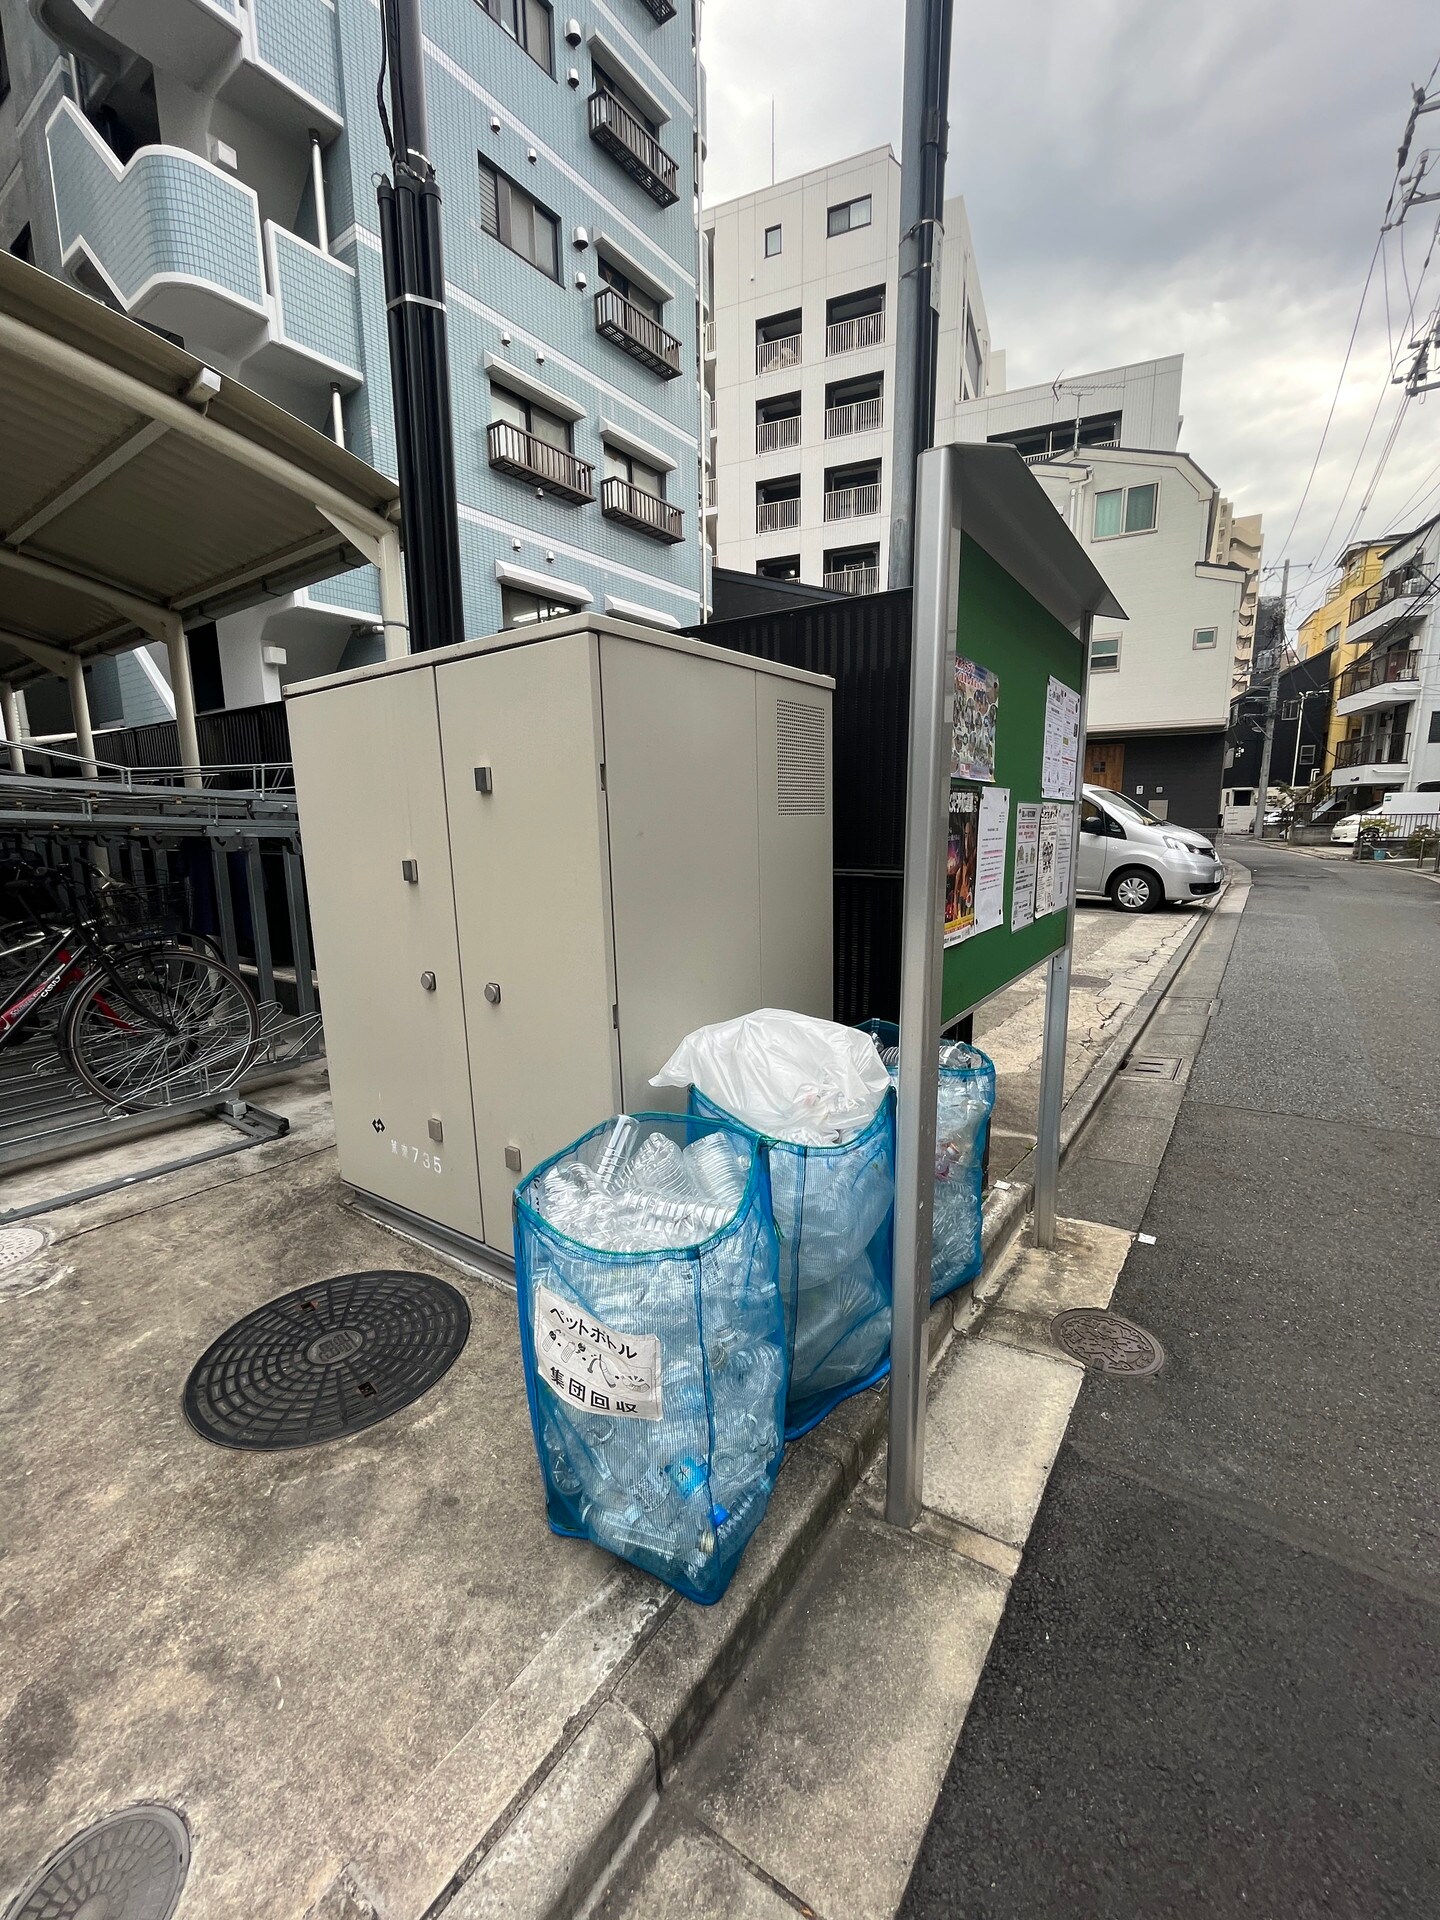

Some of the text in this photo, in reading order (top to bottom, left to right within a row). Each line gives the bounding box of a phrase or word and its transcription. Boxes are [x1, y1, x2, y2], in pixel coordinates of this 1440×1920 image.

[550, 1307, 638, 1360] ペットボトル
[550, 1366, 638, 1414] 集団回収
